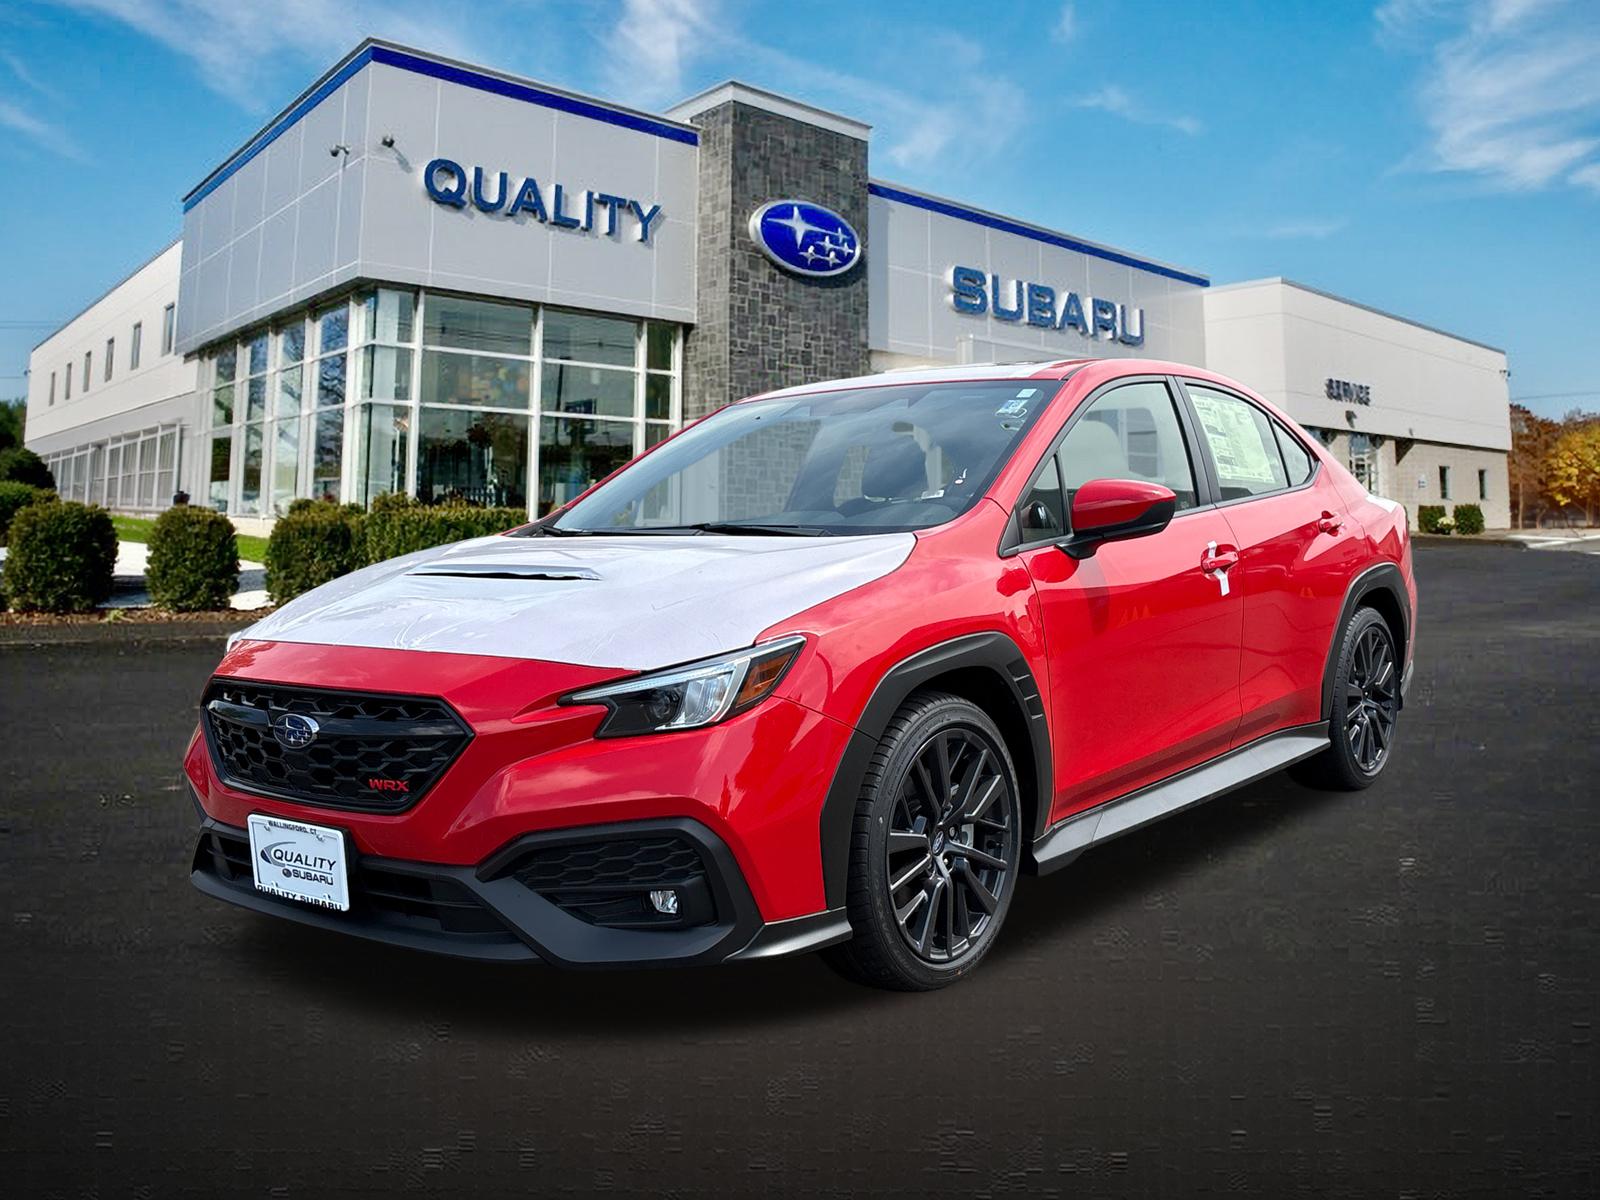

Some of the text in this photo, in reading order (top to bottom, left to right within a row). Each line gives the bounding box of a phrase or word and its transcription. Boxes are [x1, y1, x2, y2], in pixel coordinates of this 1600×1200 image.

[423, 158, 662, 243] QUALITY
[949, 265, 1145, 347] SUBARU
[1325, 378, 1371, 407] SERVICE
[368, 778, 410, 792] WRX
[273, 848, 337, 871] QUALITY
[292, 868, 334, 886] SUBARU
[257, 883, 343, 911] QUALITY SUBARU
